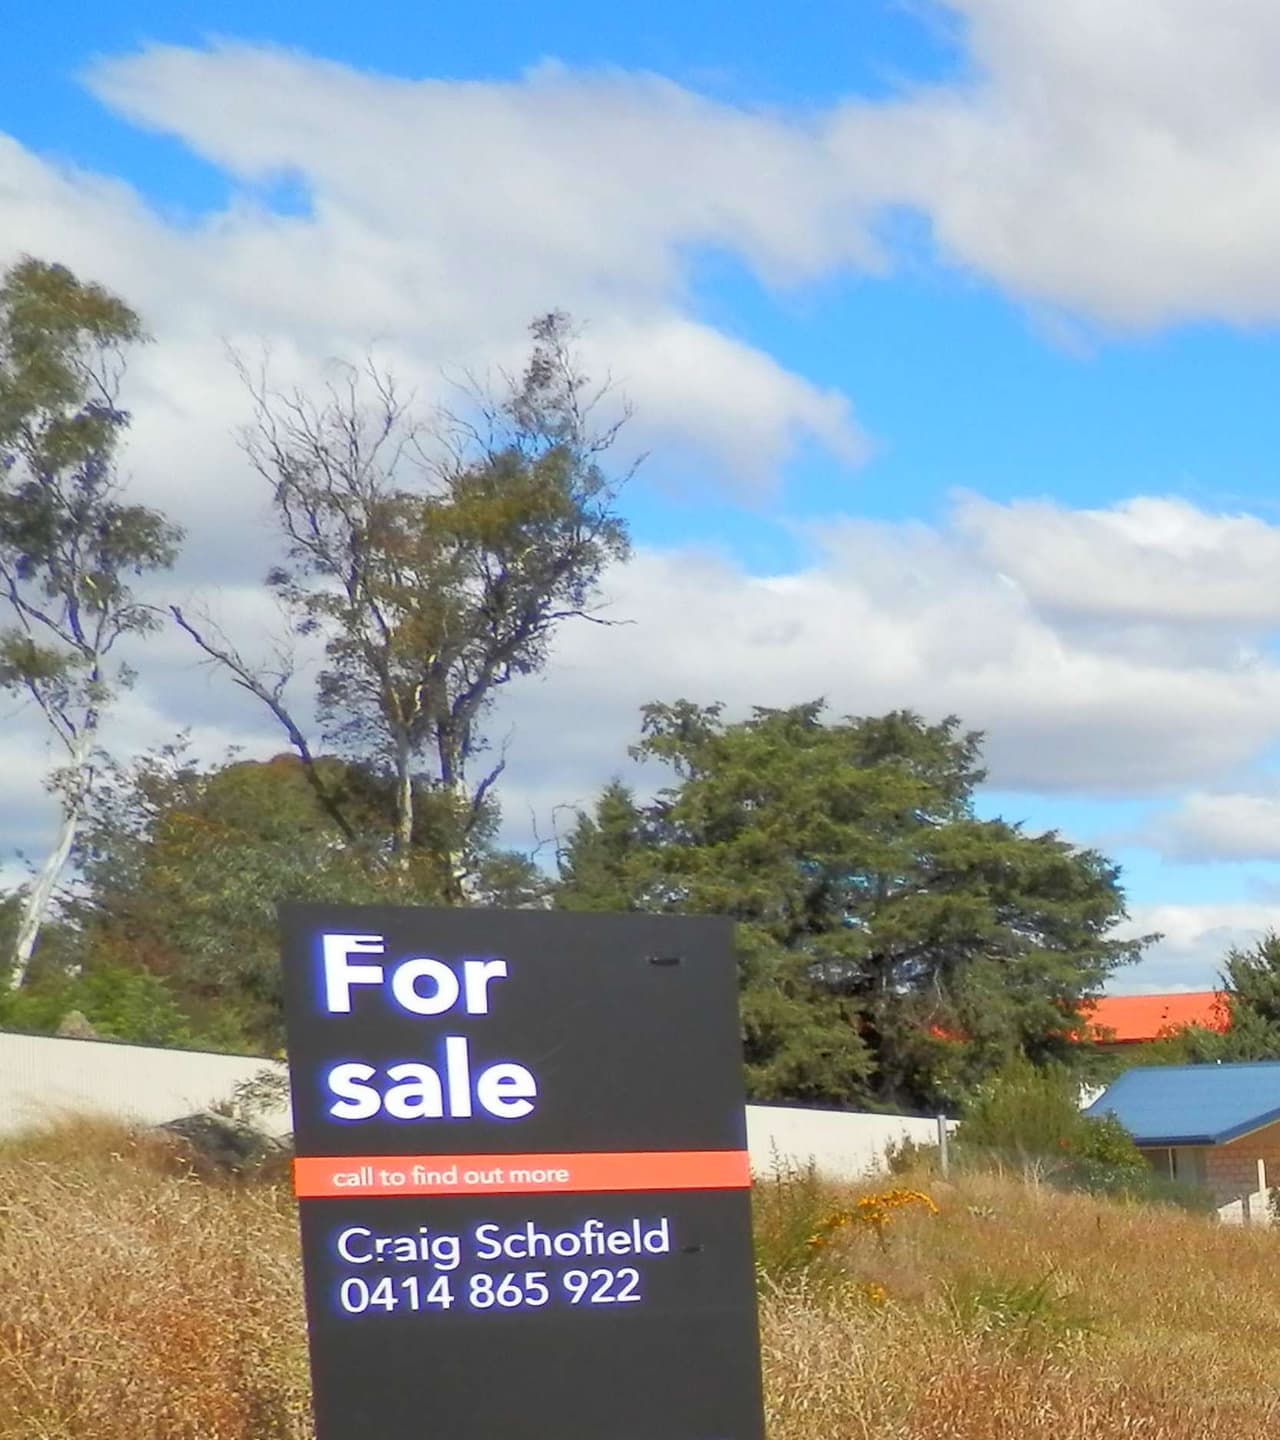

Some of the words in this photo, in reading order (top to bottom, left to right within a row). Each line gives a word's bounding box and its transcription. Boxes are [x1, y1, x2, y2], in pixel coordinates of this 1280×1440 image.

[322, 934, 507, 1015] For
[327, 1036, 538, 1120] sale
[333, 1166, 373, 1187] call
[380, 1169, 405, 1186] to
[411, 1163, 458, 1185] find
[463, 1167, 504, 1185] out
[509, 1168, 569, 1183] more
[337, 1226, 460, 1270] Craig
[475, 1217, 670, 1260] Schofield
[340, 1274, 455, 1313] 0414
[469, 1271, 549, 1308] 865
[562, 1267, 642, 1304] 922
